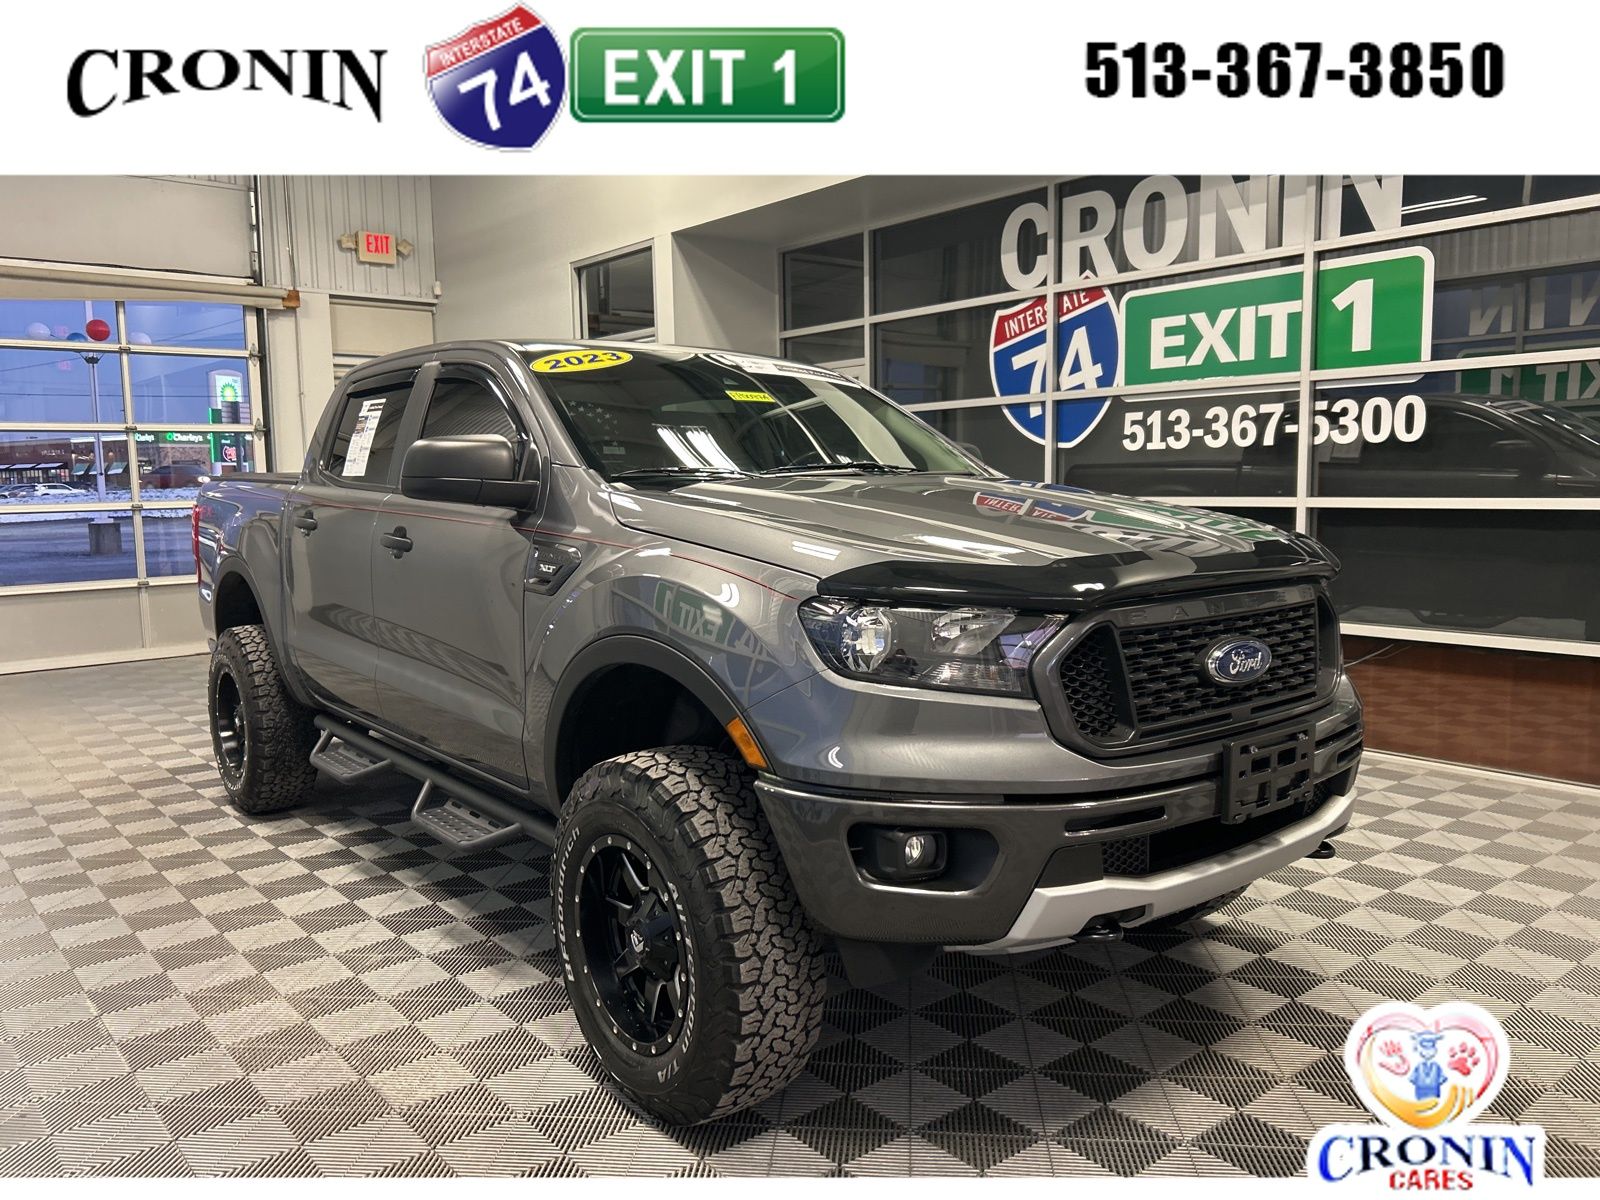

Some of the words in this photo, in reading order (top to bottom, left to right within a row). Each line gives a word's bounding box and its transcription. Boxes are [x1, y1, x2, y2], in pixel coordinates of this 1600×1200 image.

[366, 233, 390, 255] EXIT
[1000, 174, 1406, 292] CRONIN
[1004, 290, 1090, 339] INTERSATE
[1149, 299, 1303, 370] EXIT
[1331, 278, 1375, 353] 1
[543, 352, 624, 370] 2023
[1011, 326, 1104, 419] 74
[1122, 394, 1427, 452] 513-367-5300
[539, 563, 556, 573] XLT
[1229, 648, 1263, 675] Ford
[557, 826, 580, 983] BFGoodrich
[657, 1057, 681, 1084] T/A
